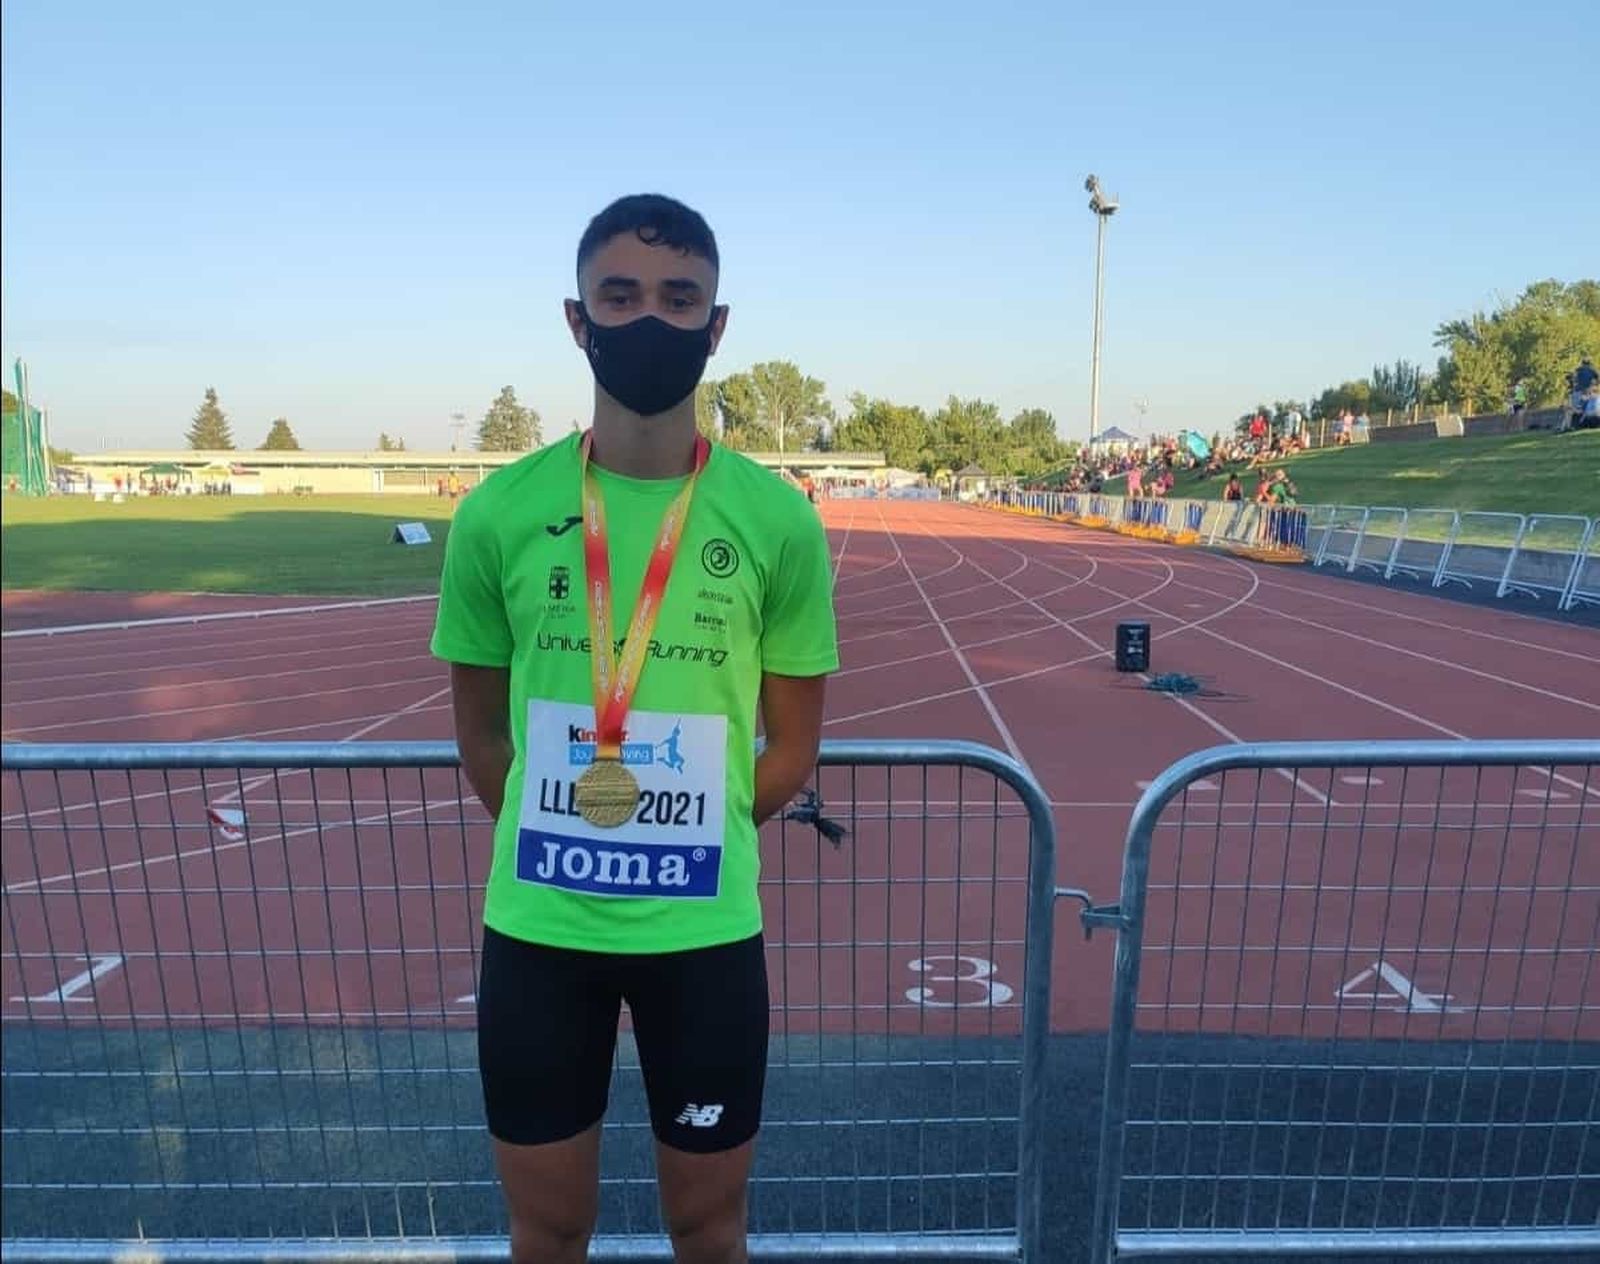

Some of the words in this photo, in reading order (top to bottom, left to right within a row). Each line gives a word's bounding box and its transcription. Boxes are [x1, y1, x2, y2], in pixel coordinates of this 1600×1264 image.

[645, 639, 728, 668] Running
[636, 790, 706, 825] 2021
[905, 955, 1013, 1007] 3
[1334, 960, 1465, 1014] 4
